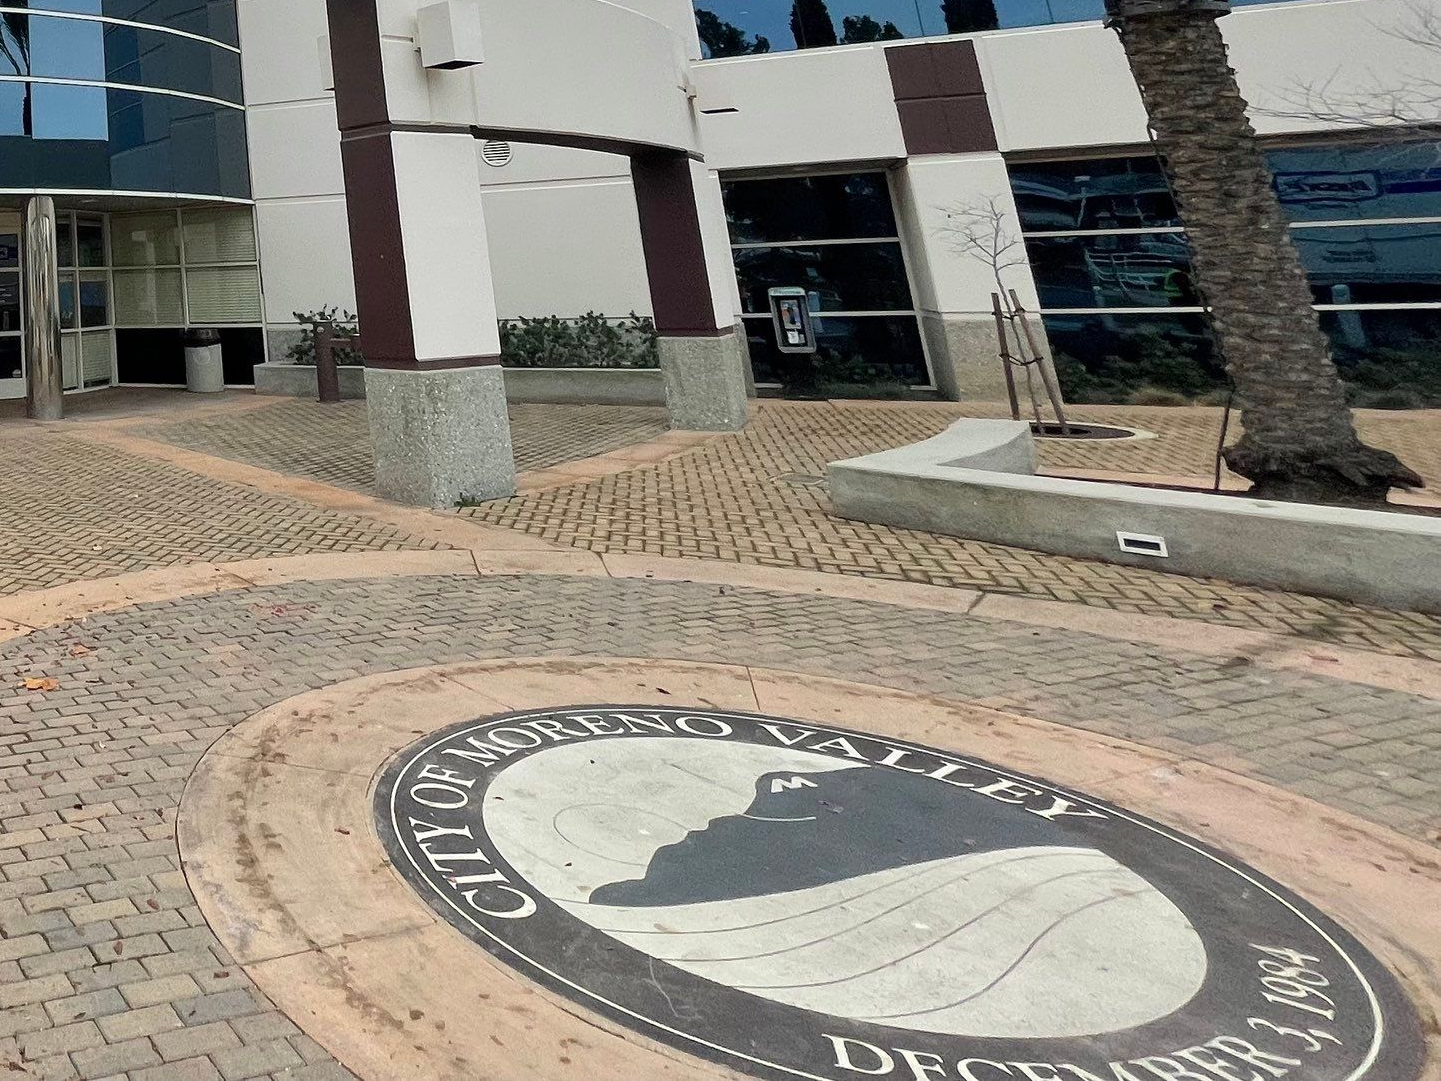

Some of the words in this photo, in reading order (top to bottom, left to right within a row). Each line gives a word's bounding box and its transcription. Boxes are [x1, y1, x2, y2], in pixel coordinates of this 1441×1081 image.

[441, 714, 734, 768] MORENO
[759, 723, 1110, 821] VALLEY
[410, 764, 476, 809] OF
[408, 816, 537, 919] CITY
[1247, 942, 1336, 1022] 1984
[1246, 1016, 1344, 1053] 3,
